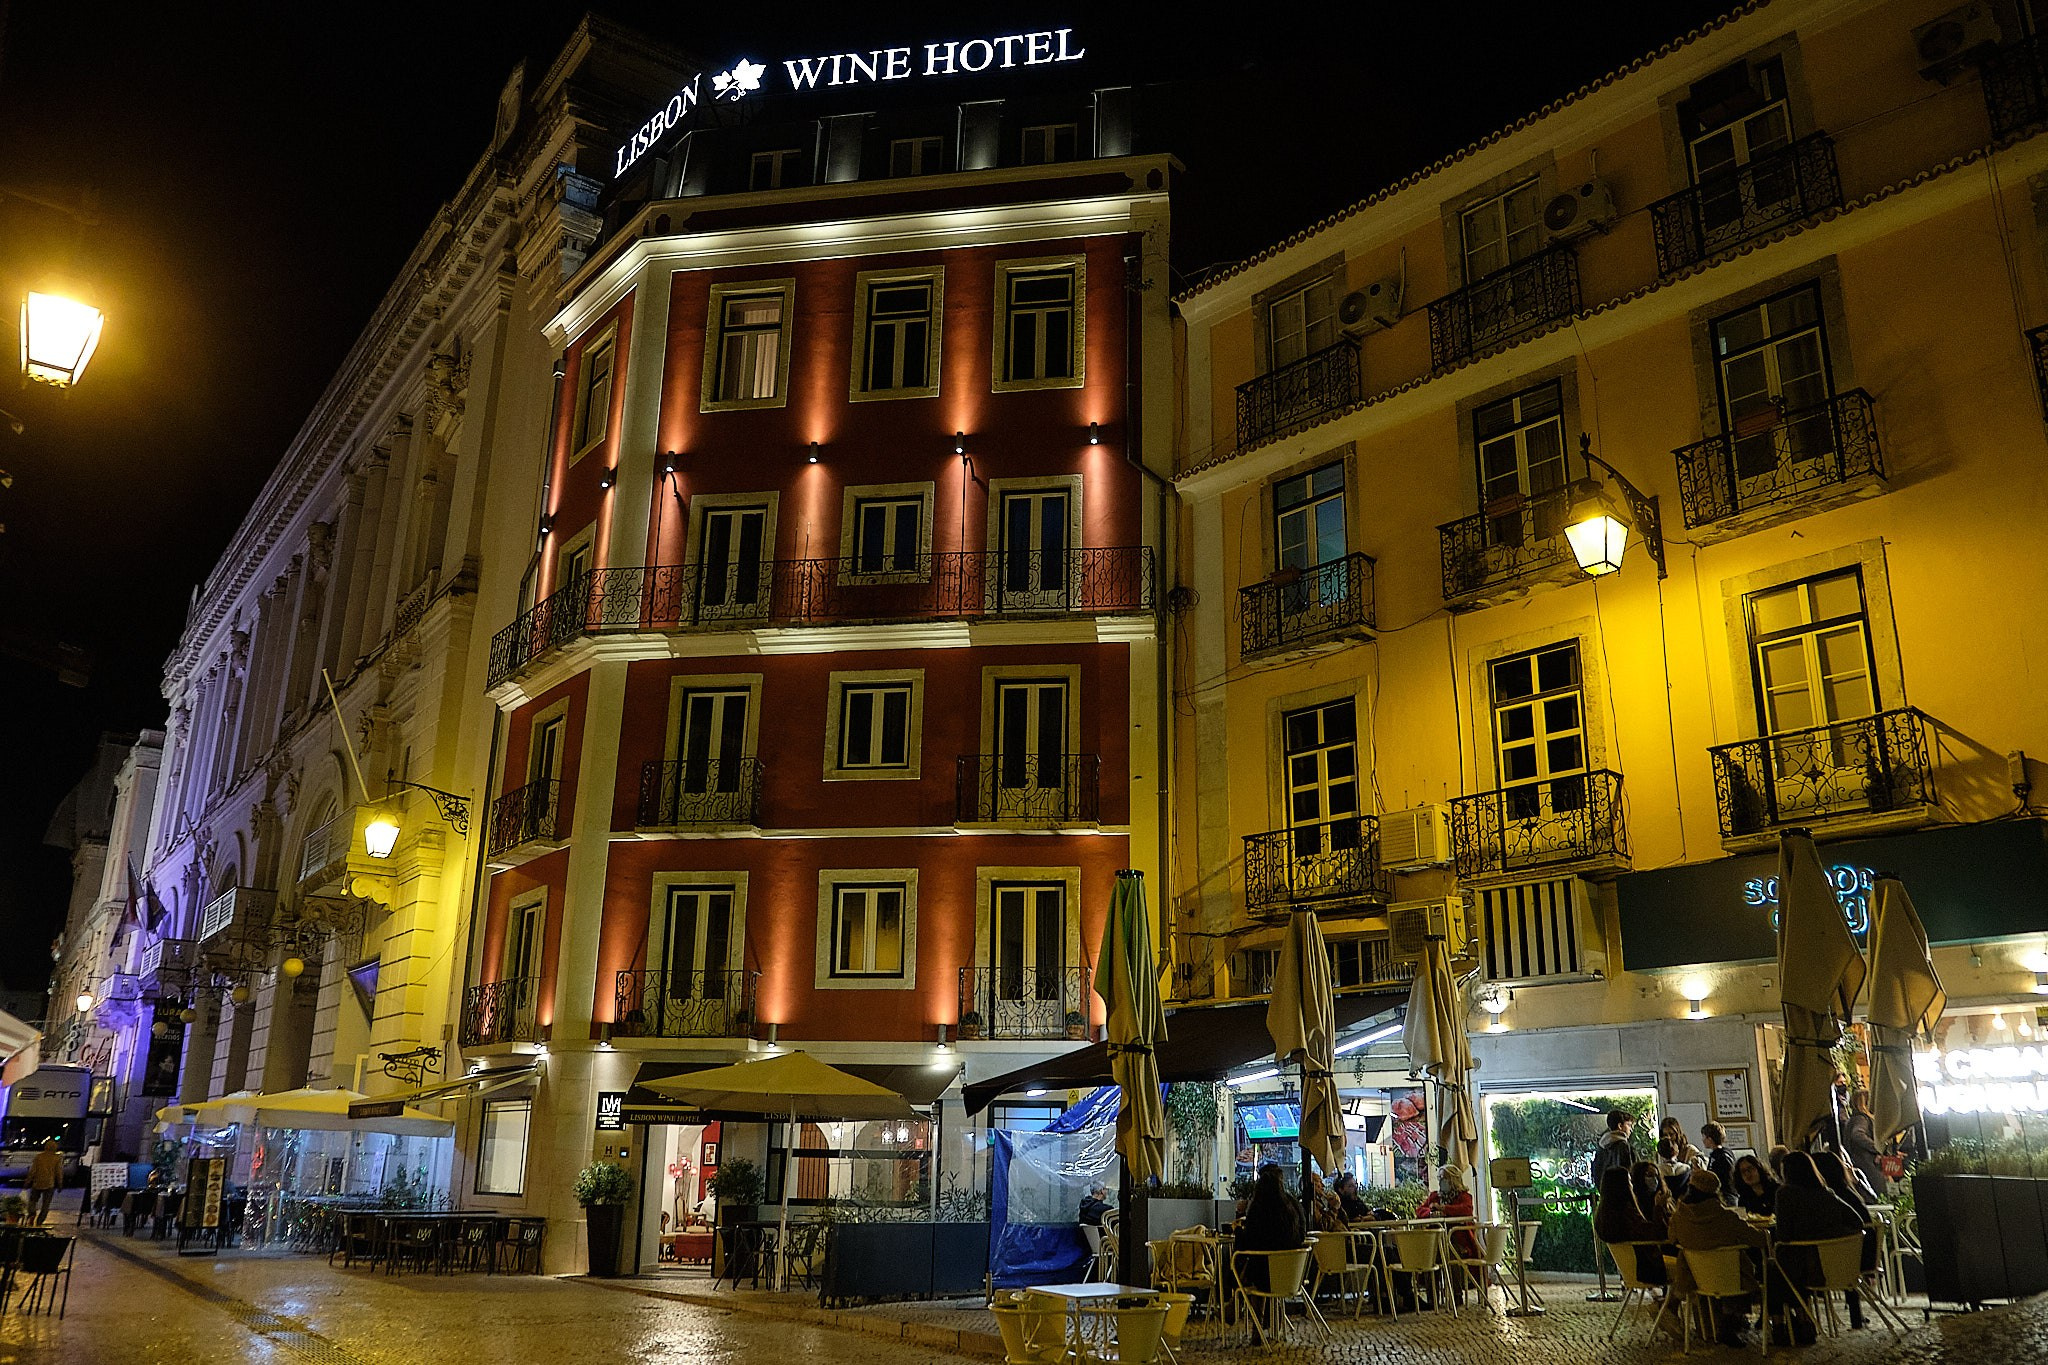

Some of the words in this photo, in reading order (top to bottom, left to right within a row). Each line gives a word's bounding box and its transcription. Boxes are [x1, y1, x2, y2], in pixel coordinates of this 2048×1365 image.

[614, 73, 701, 179] LISBON
[783, 47, 911, 91] WINE
[922, 28, 1086, 77] HOTEL
